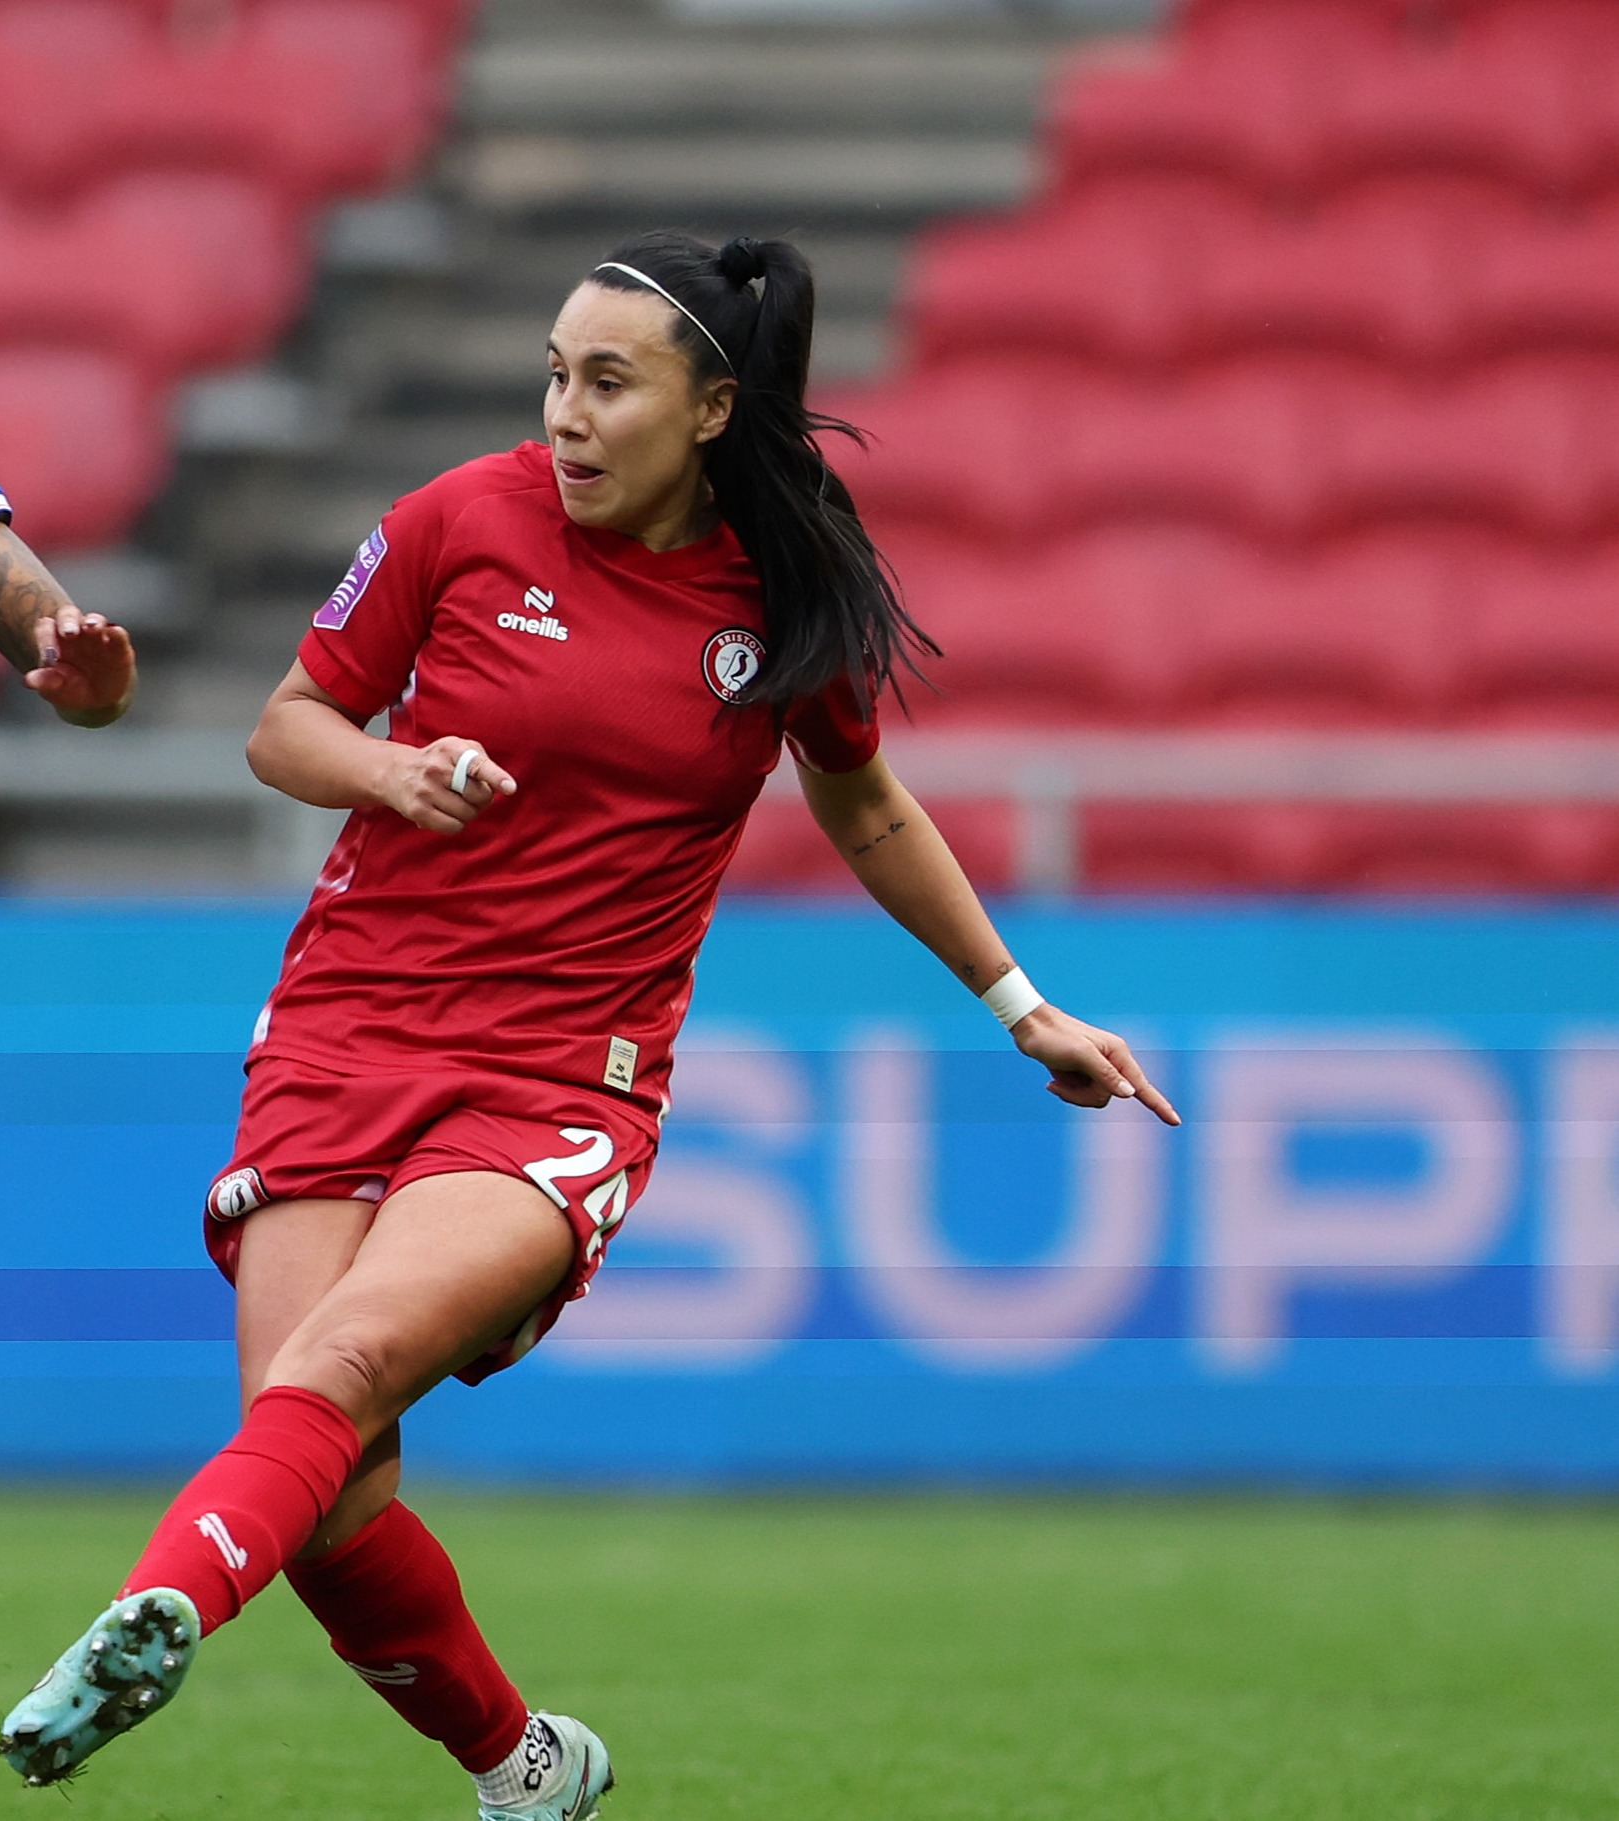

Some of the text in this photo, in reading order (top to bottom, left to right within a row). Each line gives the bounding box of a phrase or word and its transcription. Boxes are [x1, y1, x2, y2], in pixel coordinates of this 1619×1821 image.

[717, 634, 761, 654] BRISTOL
[522, 1127, 630, 1263] 24
[547, 1025, 1619, 1372] SUP
